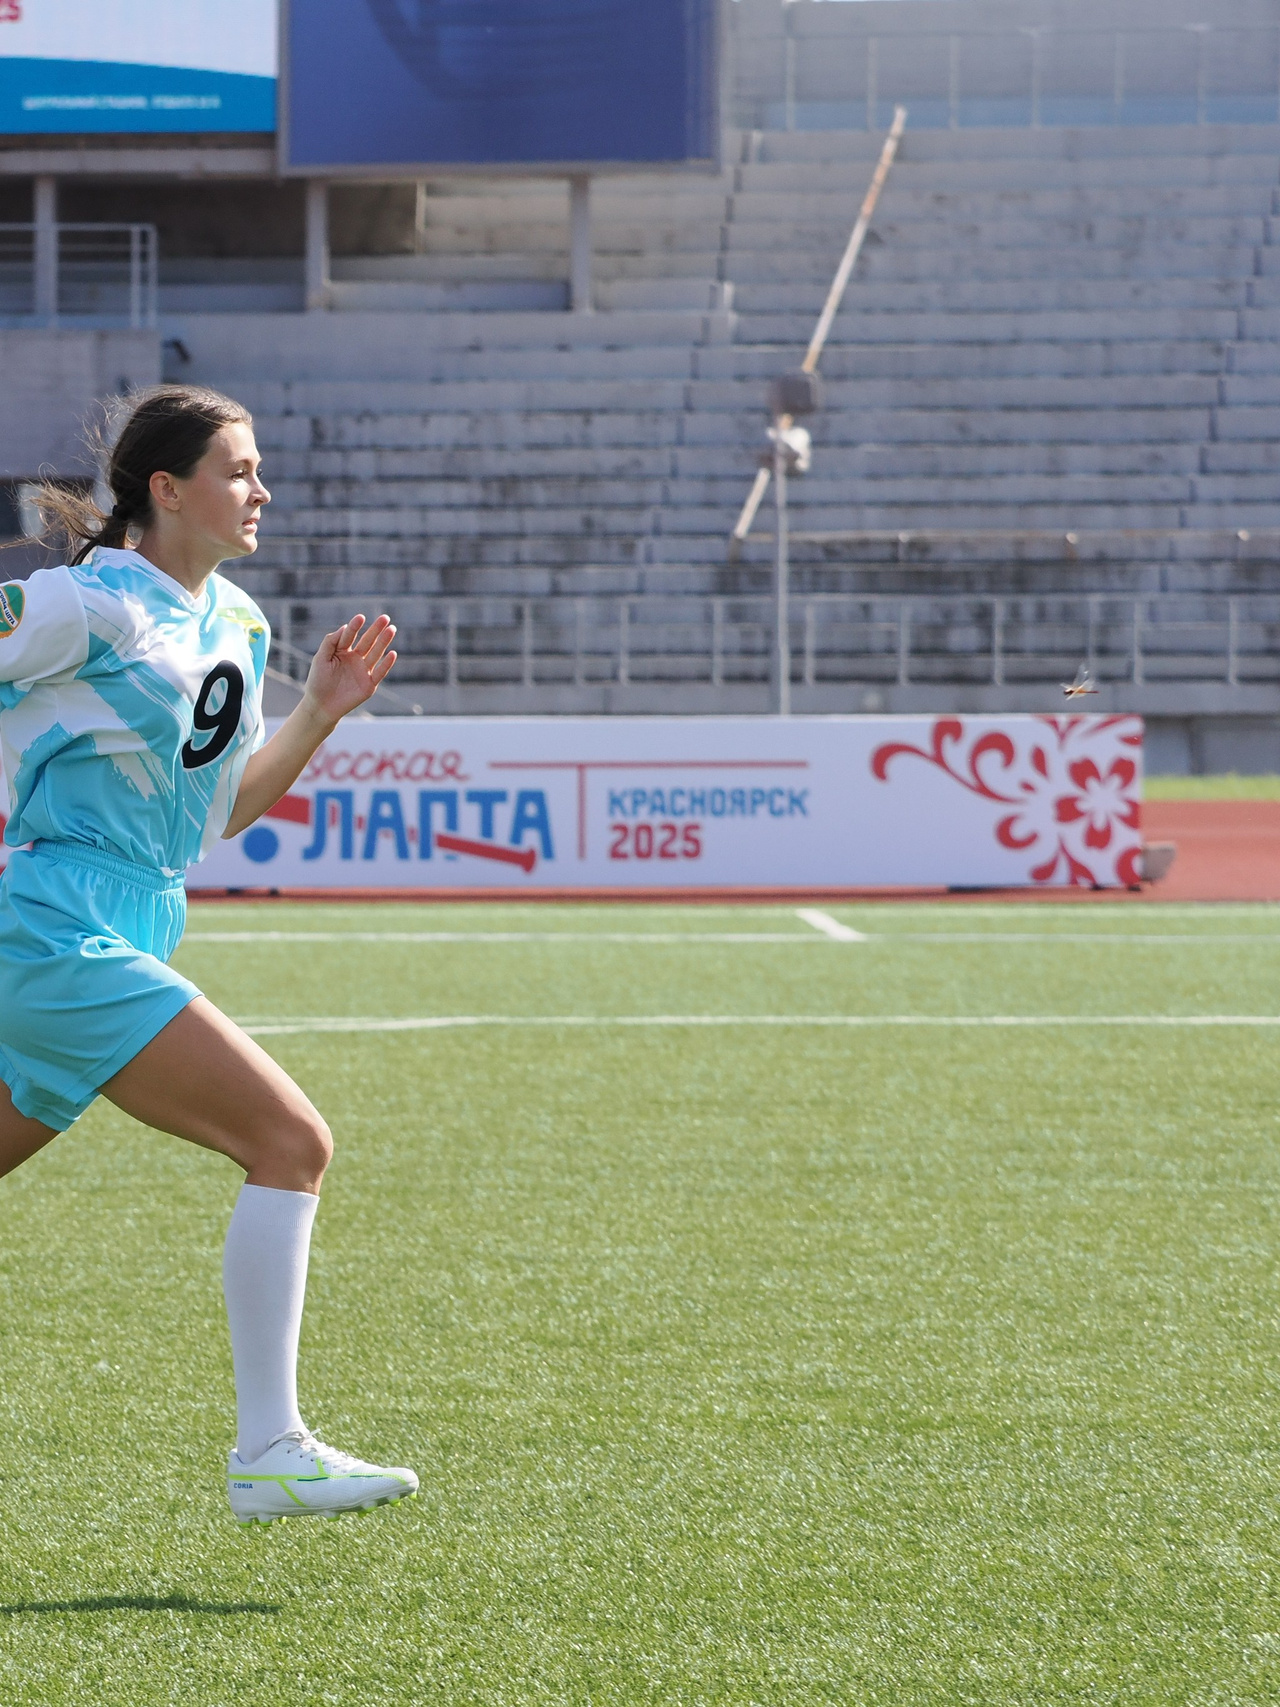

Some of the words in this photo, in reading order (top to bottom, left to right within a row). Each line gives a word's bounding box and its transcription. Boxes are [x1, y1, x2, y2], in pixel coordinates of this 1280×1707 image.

[182, 659, 244, 769] 9
[300, 743, 471, 783] усская
[608, 788, 811, 818] КРАСНОЯРСК
[302, 790, 556, 861] ЛАПТА
[608, 824, 703, 861] 2025
